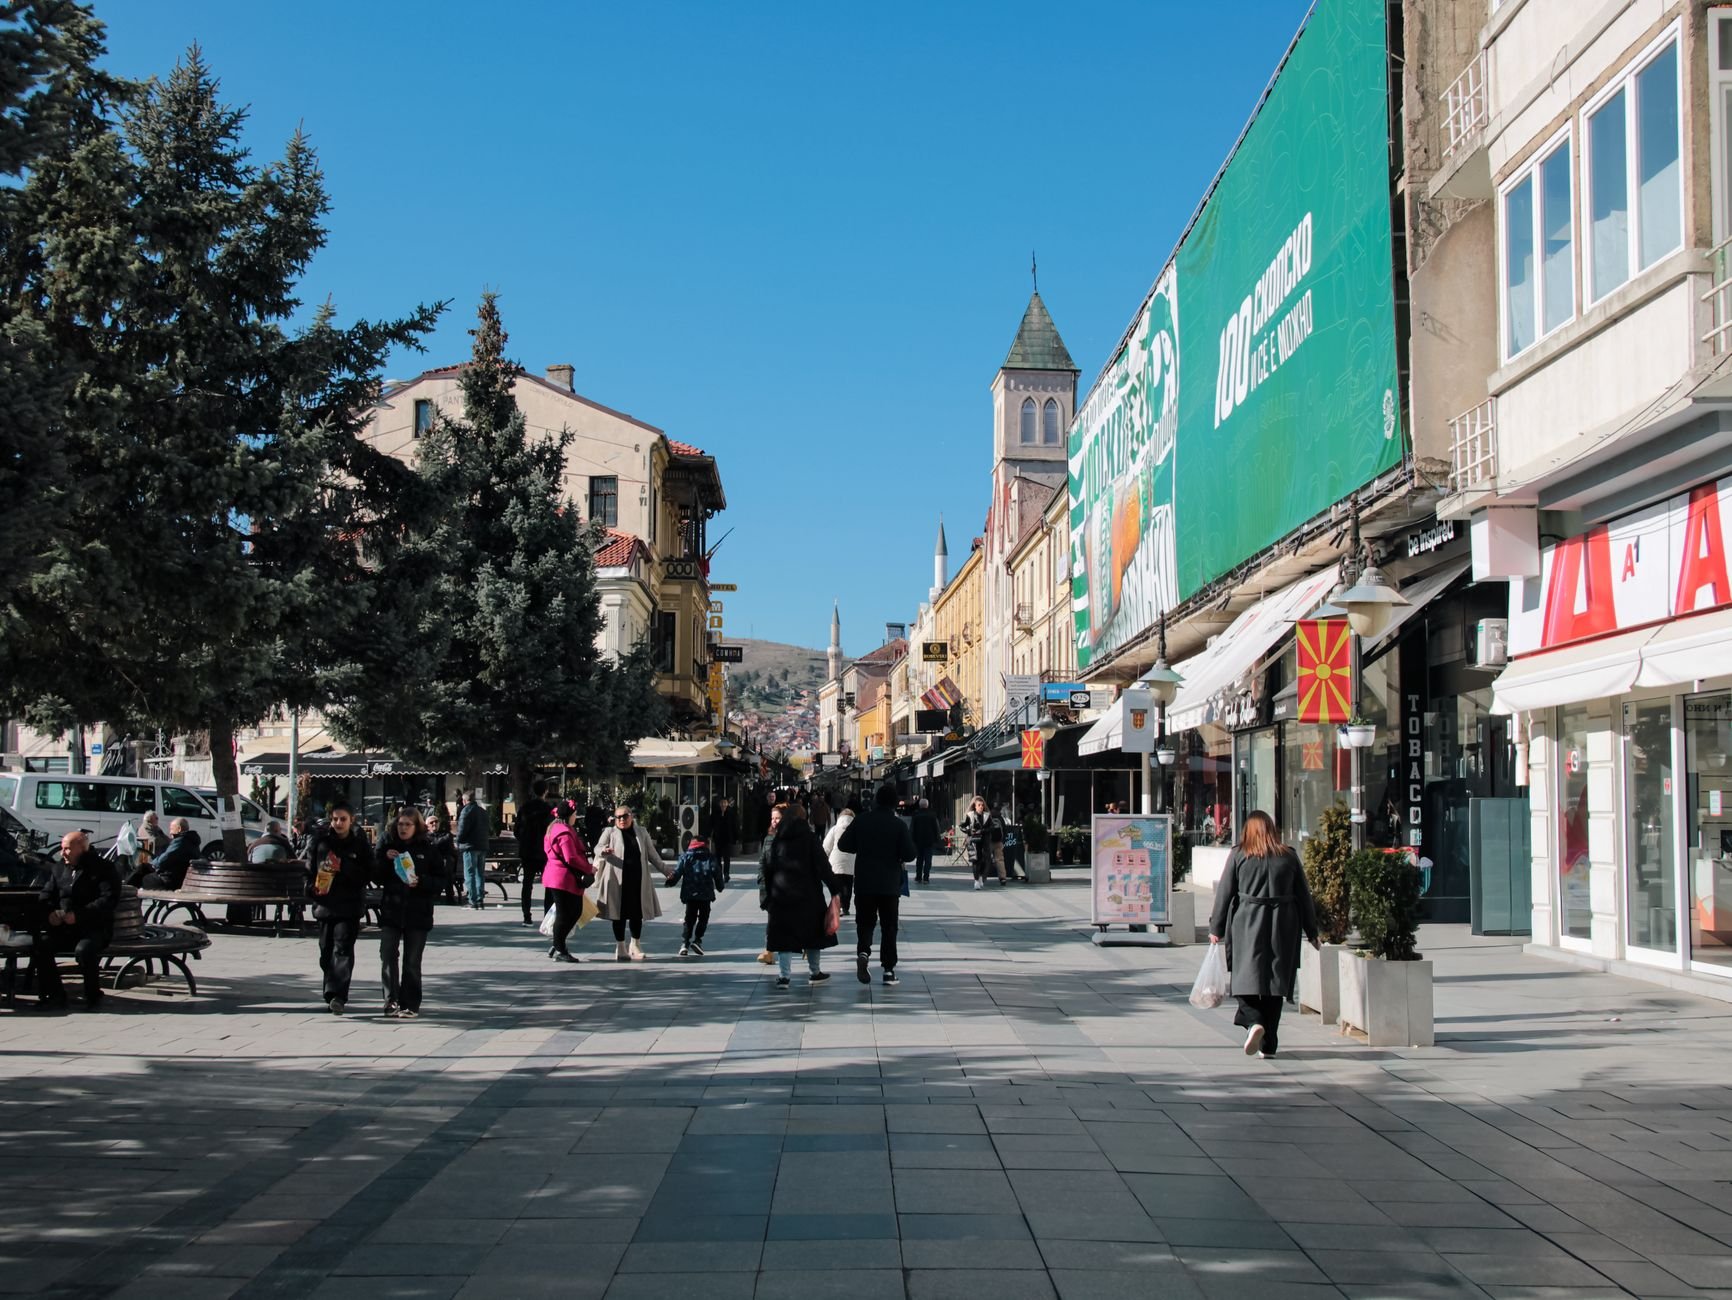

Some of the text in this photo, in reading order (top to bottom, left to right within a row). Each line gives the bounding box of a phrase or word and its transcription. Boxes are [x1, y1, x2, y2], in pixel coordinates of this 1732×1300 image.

[1214, 211, 1312, 430] 100 СКОПСКО
[1277, 289, 1313, 366] МОЖНО
[1408, 534, 1419, 557] be
[1073, 694, 1088, 702] 925
